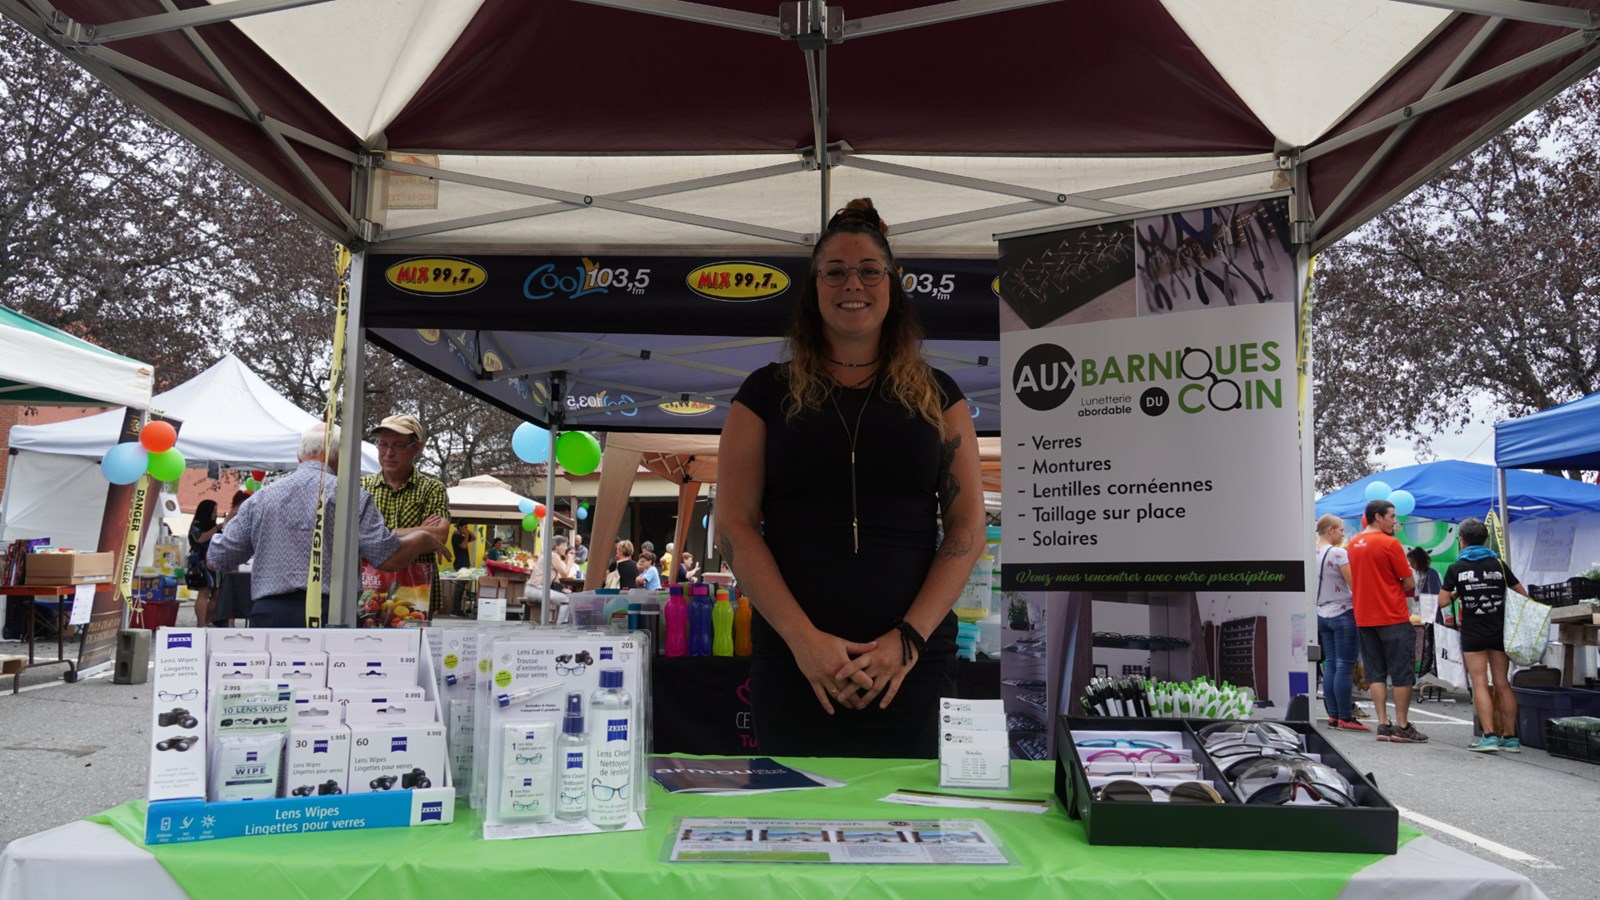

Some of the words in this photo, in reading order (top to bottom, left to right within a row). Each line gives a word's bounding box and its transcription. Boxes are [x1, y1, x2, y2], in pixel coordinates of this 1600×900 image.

[397, 266, 429, 284] MIX
[433, 268, 471, 286] 99,7
[587, 268, 651, 292] 103,5
[698, 272, 730, 289] MIX
[735, 273, 773, 292] 99,7
[900, 273, 955, 297] 03,5
[1015, 361, 1078, 393] AUX
[1081, 341, 1281, 387] BARNIQUES
[1081, 393, 1132, 406] Lunetterie
[1146, 396, 1163, 407] DU
[1178, 378, 1283, 414] COIN
[1078, 405, 1132, 417] abordable
[1032, 435, 1082, 451] Verres
[1032, 458, 1112, 475] Montures
[1033, 481, 1101, 498] Lentilles
[1107, 478, 1213, 496] cornéennes
[131, 489, 145, 532] DANGER
[1032, 506, 1097, 525] Taillage
[1102, 509, 1130, 521] sur
[1136, 503, 1186, 523] place
[1032, 530, 1098, 546] Solaires
[122, 544, 137, 584] DANGER
[1016, 569, 1053, 586] Venez
[1056, 573, 1080, 582] nous
[1084, 571, 1141, 582] rencontrer
[1144, 572, 1172, 582] avec
[1175, 571, 1206, 582] votre
[1207, 570, 1286, 586] prescription
[236, 706, 258, 714] LENS
[261, 704, 288, 713] WIPES
[295, 740, 307, 748] 30
[356, 738, 369, 746] 60
[369, 756, 387, 764] Wipes
[235, 767, 266, 775] WIPE
[354, 765, 380, 773] Lingettes
[275, 809, 301, 820] Lens
[305, 806, 340, 819] Wipes
[245, 823, 298, 836] Lingettes
[302, 821, 328, 833] pour
[332, 818, 366, 829] verres
